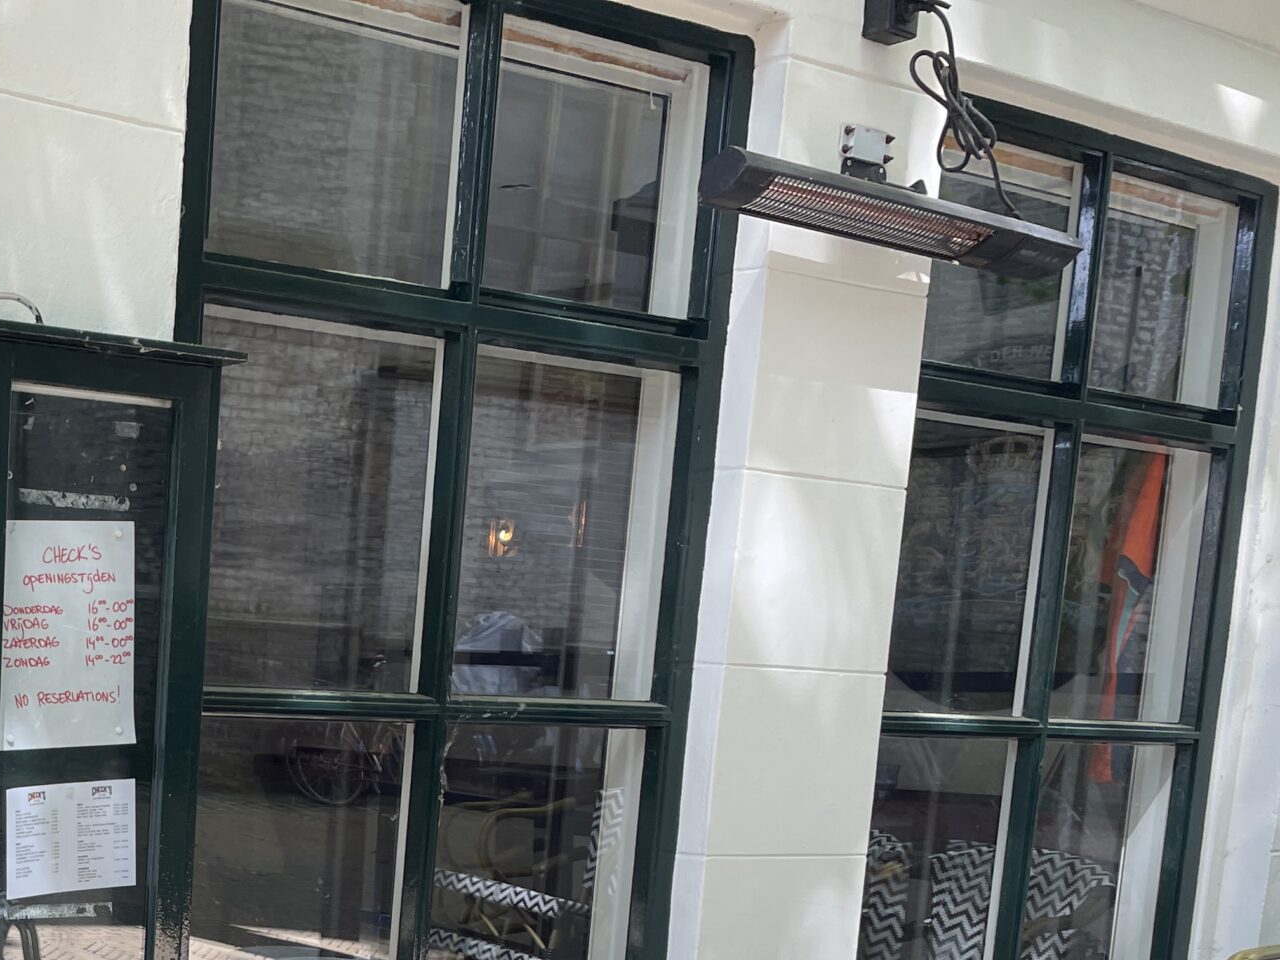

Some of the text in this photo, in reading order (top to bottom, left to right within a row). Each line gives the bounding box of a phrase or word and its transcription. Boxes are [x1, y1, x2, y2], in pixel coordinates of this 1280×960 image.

[42, 543, 102, 563] CHECK'S
[2, 604, 63, 615] DONDERDAG
[3, 636, 60, 649] ZATERDAG
[4, 656, 50, 668] ZONDAG
[14, 694, 29, 708] NO
